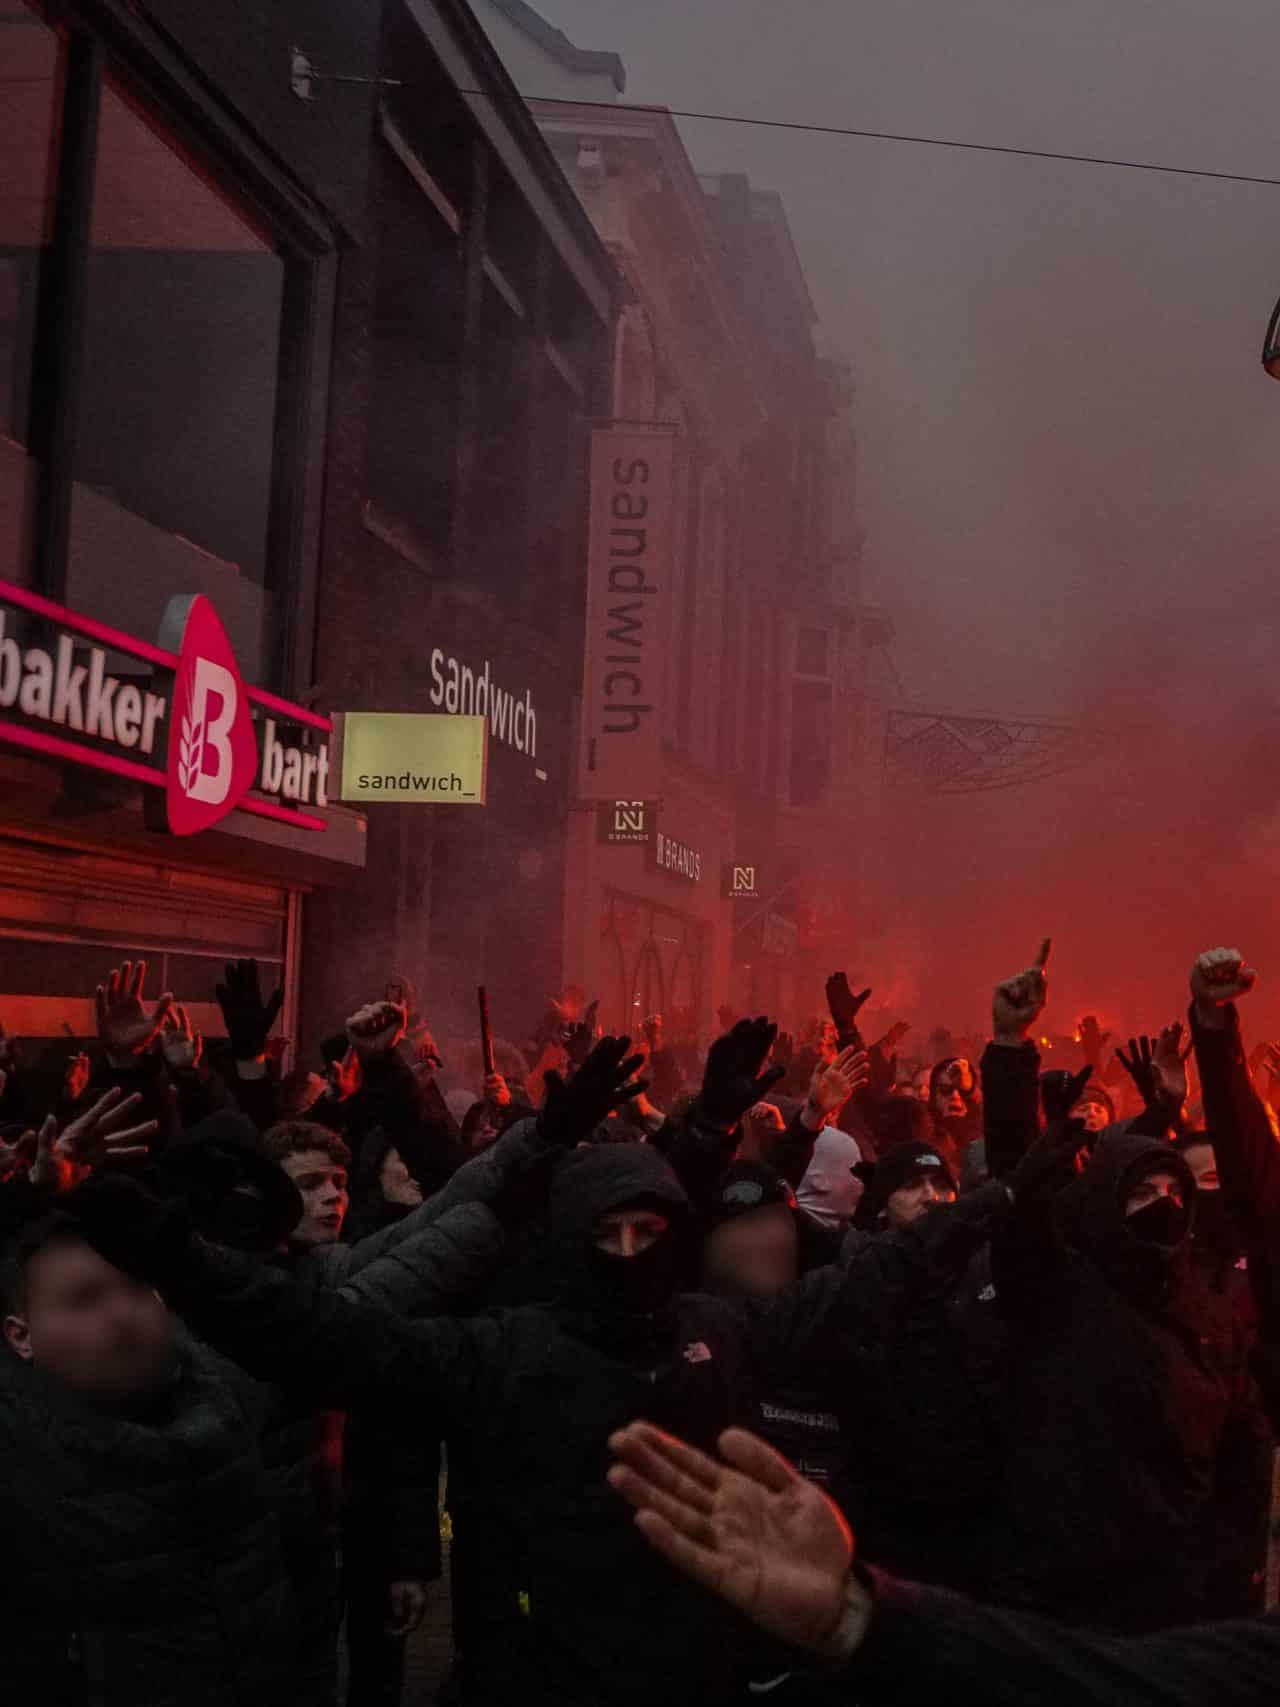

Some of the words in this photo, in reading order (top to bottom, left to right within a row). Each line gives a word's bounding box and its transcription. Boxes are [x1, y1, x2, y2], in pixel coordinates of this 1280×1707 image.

[0, 609, 165, 754] bakker
[261, 718, 328, 807] bart
[185, 656, 237, 805] B
[665, 839, 701, 881] BRANDS
